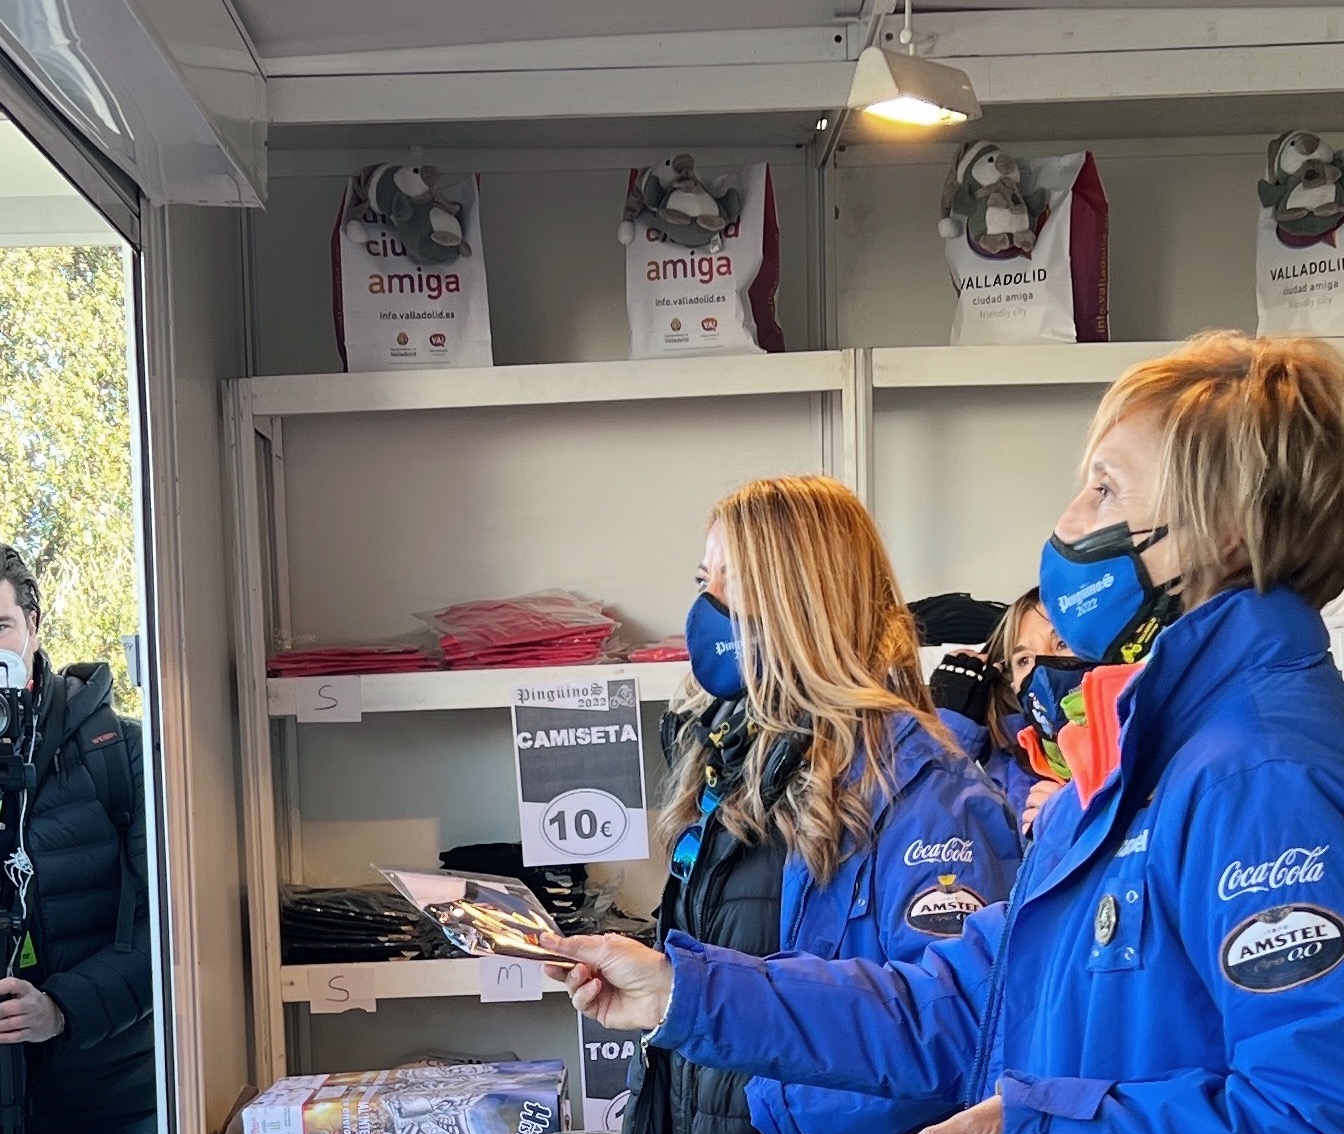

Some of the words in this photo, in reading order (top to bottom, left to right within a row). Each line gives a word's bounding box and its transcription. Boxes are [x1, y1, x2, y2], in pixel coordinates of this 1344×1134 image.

[646, 250, 732, 284] amiga
[368, 267, 460, 300] amiga
[1310, 280, 1339, 291] amiga
[655, 294, 726, 307] info.valladolid.es
[972, 292, 1002, 306] ciudad
[1005, 291, 1034, 303] amiga
[379, 310, 455, 320] info.valladolid.es
[979, 308, 1011, 319] friendly
[1013, 307, 1027, 318] city
[314, 684, 339, 711] S
[577, 697, 606, 708] 2022
[517, 724, 637, 750] CAMISETA
[548, 809, 613, 841] 10€
[904, 837, 974, 866] Coca-Cola
[1218, 844, 1330, 901] Coca-Cola
[1239, 924, 1329, 960] AMSTEL
[324, 975, 350, 1002] S
